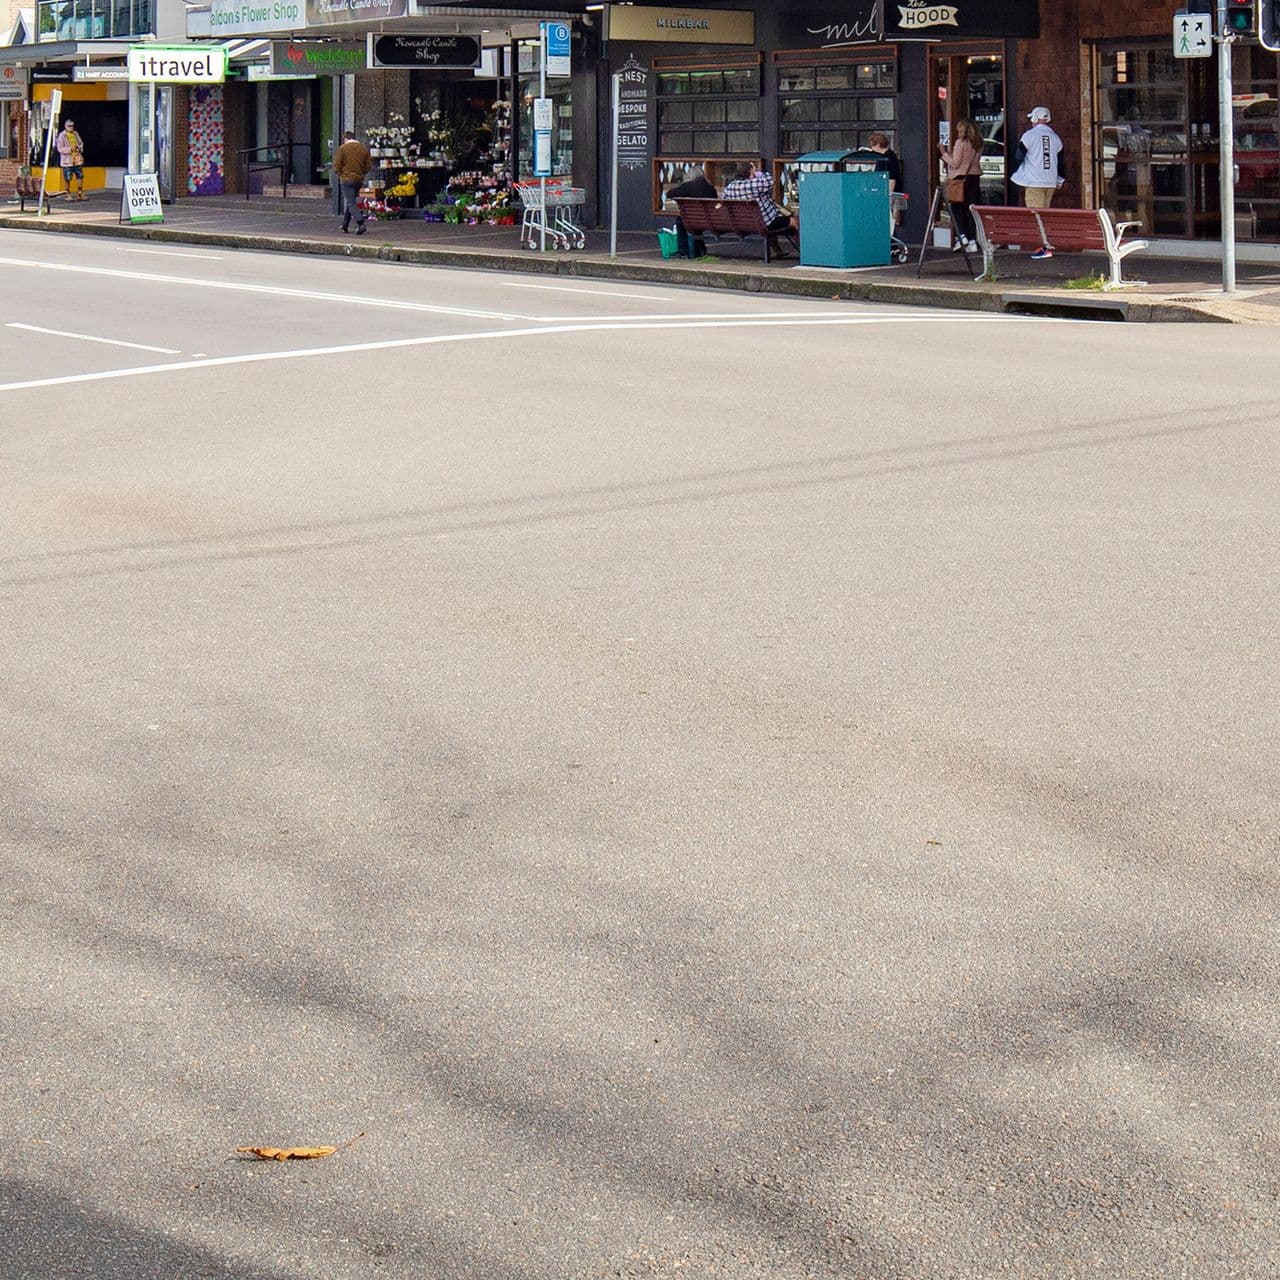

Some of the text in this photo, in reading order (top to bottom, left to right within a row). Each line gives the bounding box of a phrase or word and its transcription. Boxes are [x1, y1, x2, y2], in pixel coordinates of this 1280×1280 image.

[241, 4, 271, 24] Flower
[273, 1, 299, 21] Shop
[906, 8, 950, 25] HOOD
[656, 18, 710, 30] MILKBAR
[807, 2, 878, 40] mil
[415, 48, 440, 65] Shop
[139, 54, 213, 77] itravel
[624, 70, 648, 84] NEST
[621, 89, 648, 98] ANDMADE
[619, 120, 648, 129] RADITIONAL
[1042, 135, 1051, 153] NIKE
[131, 187, 156, 197] NOW
[131, 197, 159, 208] OPEN
